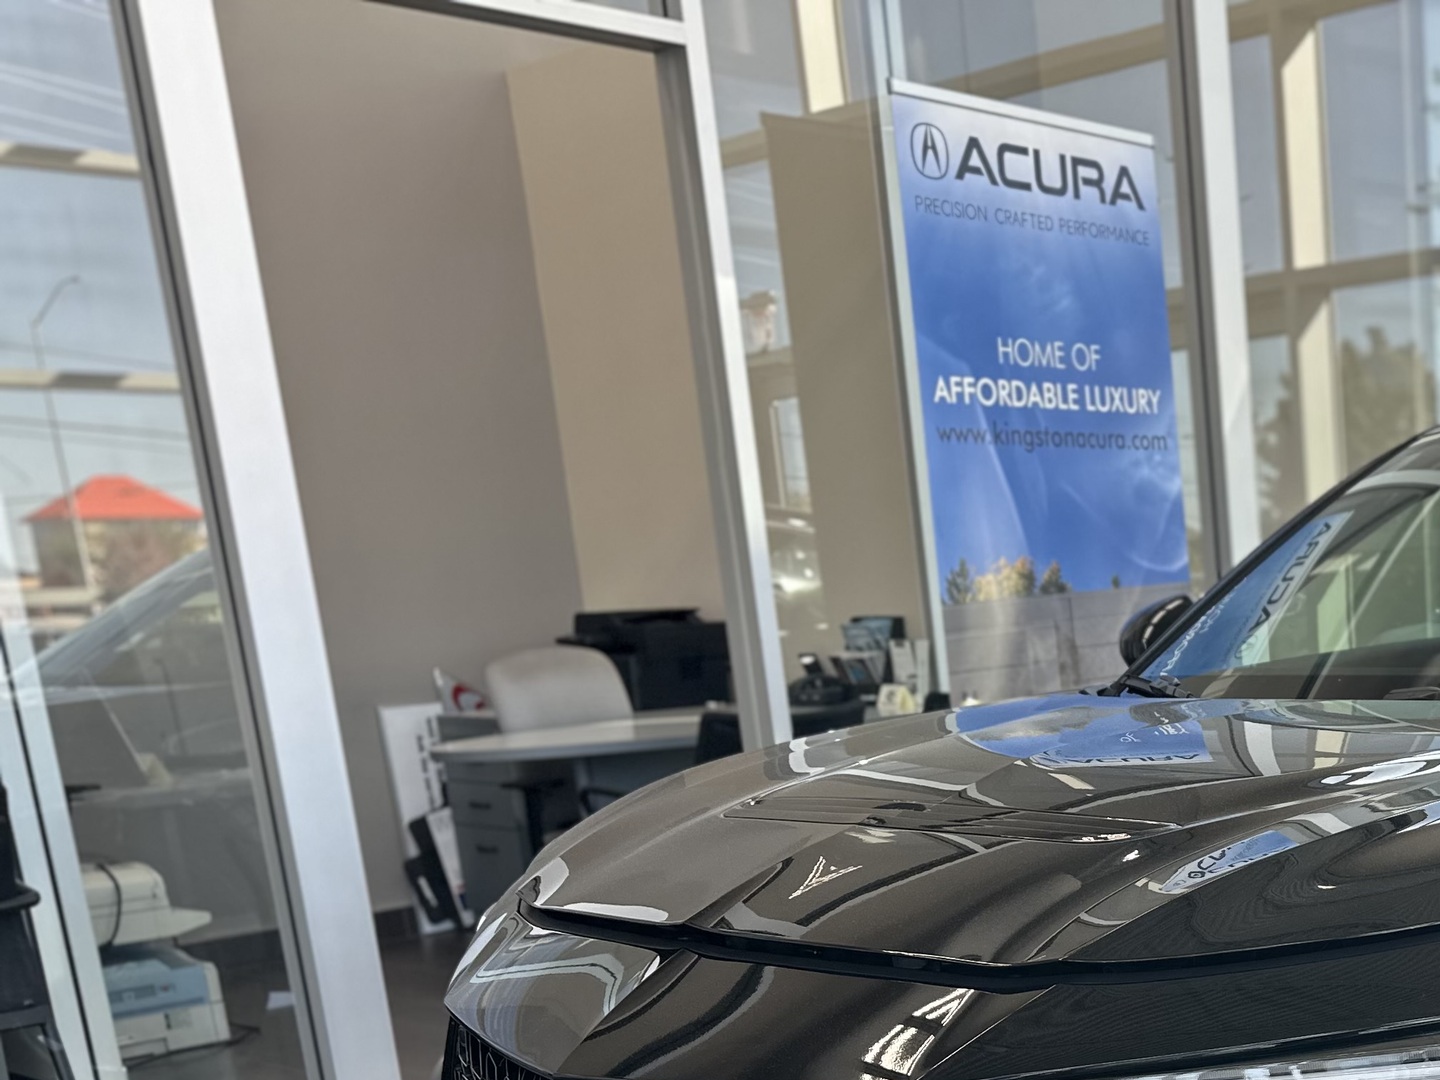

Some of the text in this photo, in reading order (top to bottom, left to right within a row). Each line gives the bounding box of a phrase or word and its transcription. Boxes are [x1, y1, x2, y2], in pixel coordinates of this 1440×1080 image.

[955, 136, 1147, 212] ACURA
[914, 195, 1150, 246] PRECISION CRAFTED PERFORMANCE
[997, 337, 1101, 371] HOME OF
[933, 375, 1161, 414] AFFORDABLE LUXURY
[936, 419, 1168, 454] www.kingstonacura.com
